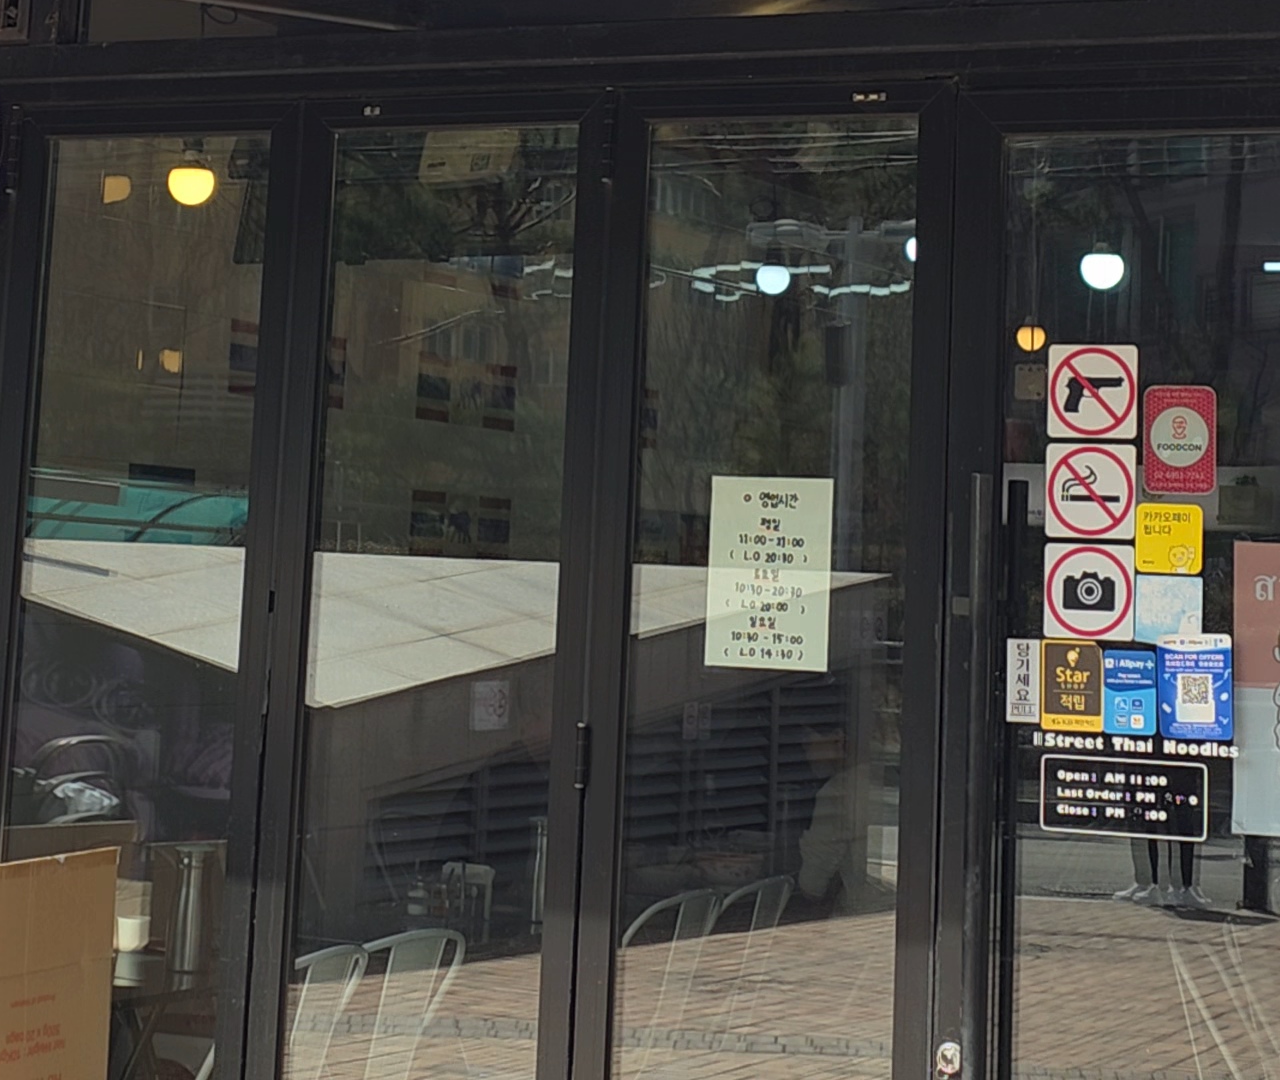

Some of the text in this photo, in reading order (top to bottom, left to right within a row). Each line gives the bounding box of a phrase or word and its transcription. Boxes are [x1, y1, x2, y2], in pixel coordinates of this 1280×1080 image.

[1157, 443, 1203, 452] FOODCON
[759, 491, 799, 509] 영업시간
[1143, 511, 1191, 524] 카카오페이
[1056, 666, 1090, 683] Star
[1060, 694, 1085, 711] 적립
[1044, 732, 1104, 750] Street
[1112, 736, 1154, 753] Thai
[1163, 740, 1240, 758] Noodles
[1104, 772, 1125, 784] AM
[1057, 787, 1083, 798] Last
[1136, 792, 1156, 803] PM
[1105, 807, 1125, 819] PM
